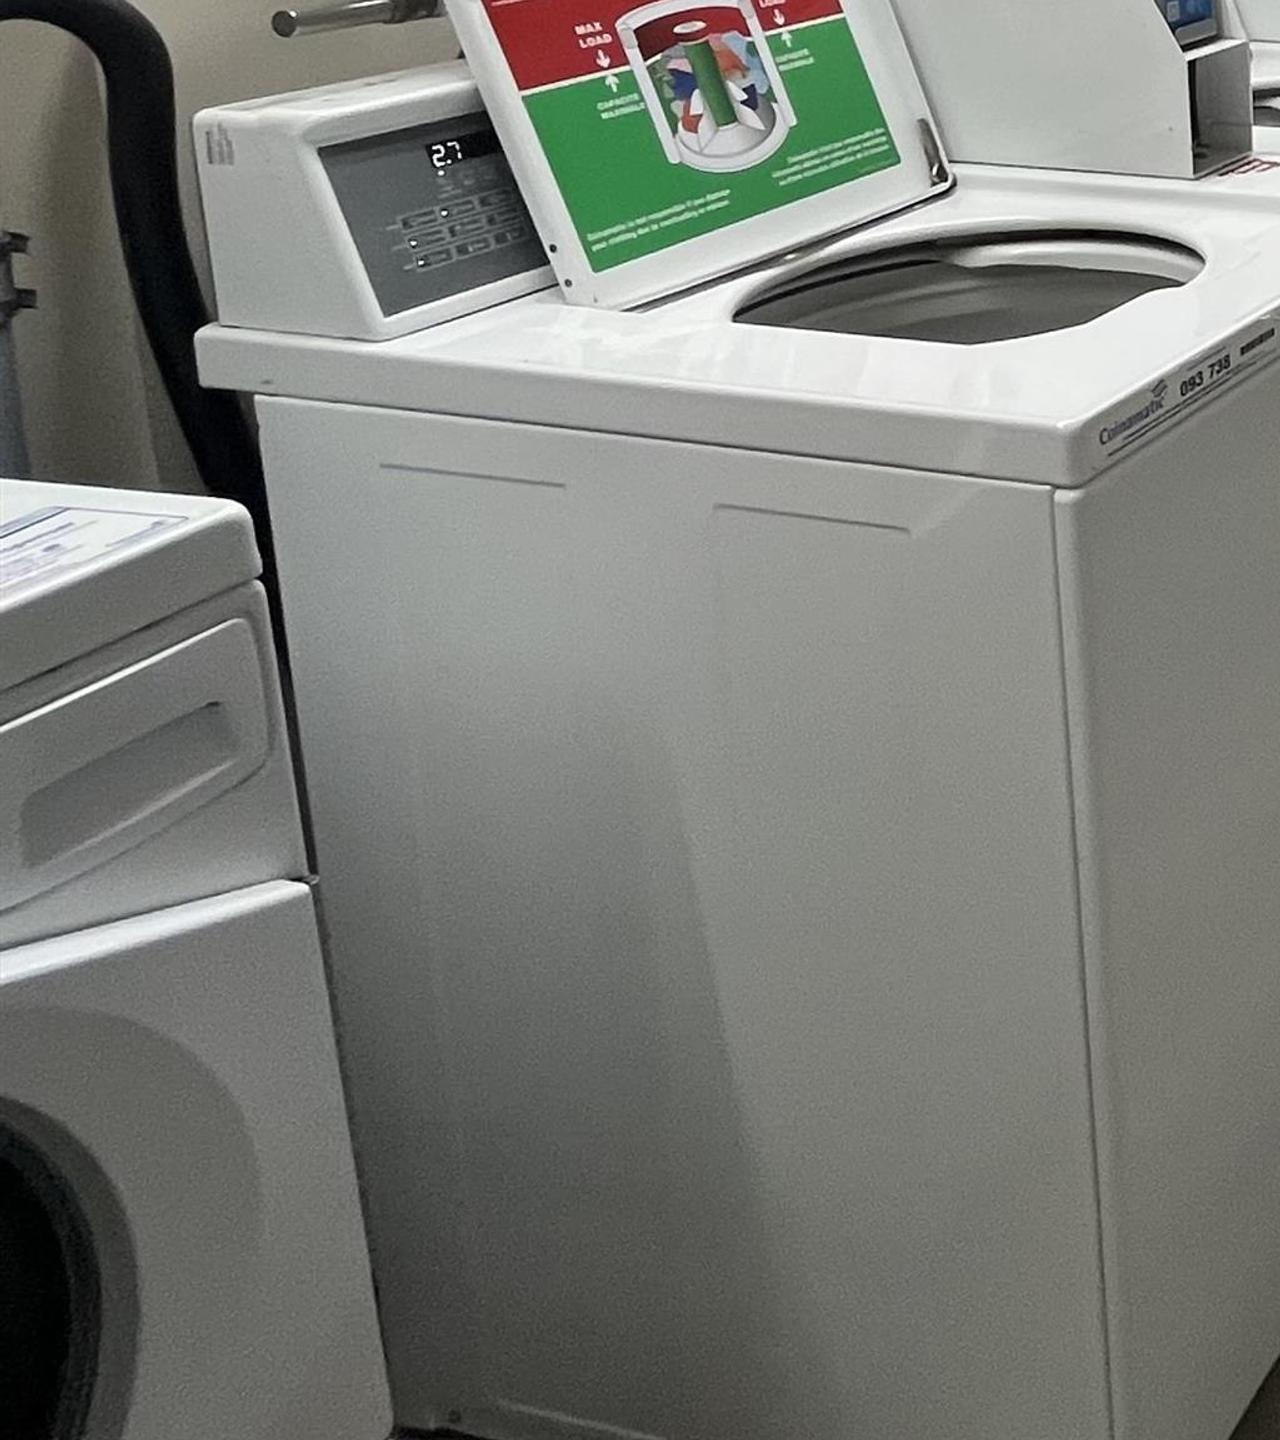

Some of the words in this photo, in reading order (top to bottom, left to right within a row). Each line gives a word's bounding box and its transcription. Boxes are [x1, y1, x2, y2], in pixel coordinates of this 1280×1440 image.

[574, 22, 602, 35] MAX
[579, 33, 613, 48] LOAD
[1180, 371, 1204, 397] 093
